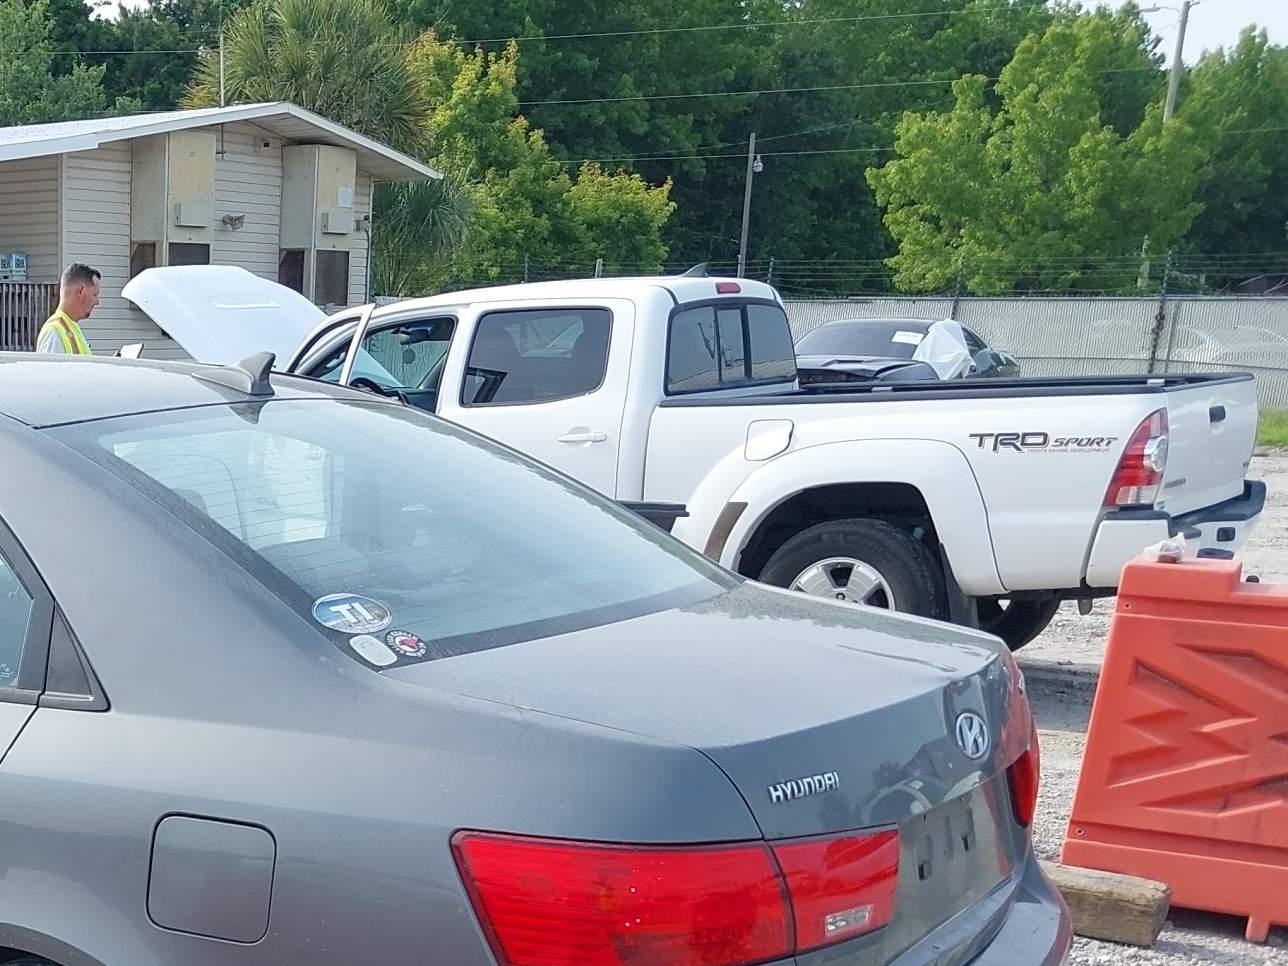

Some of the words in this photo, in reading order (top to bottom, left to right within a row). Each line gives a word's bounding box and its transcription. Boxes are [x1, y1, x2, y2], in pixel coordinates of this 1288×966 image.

[968, 432, 1049, 453] TRD
[1051, 437, 1118, 448] SPORT
[768, 771, 840, 803] HYUNDAI
